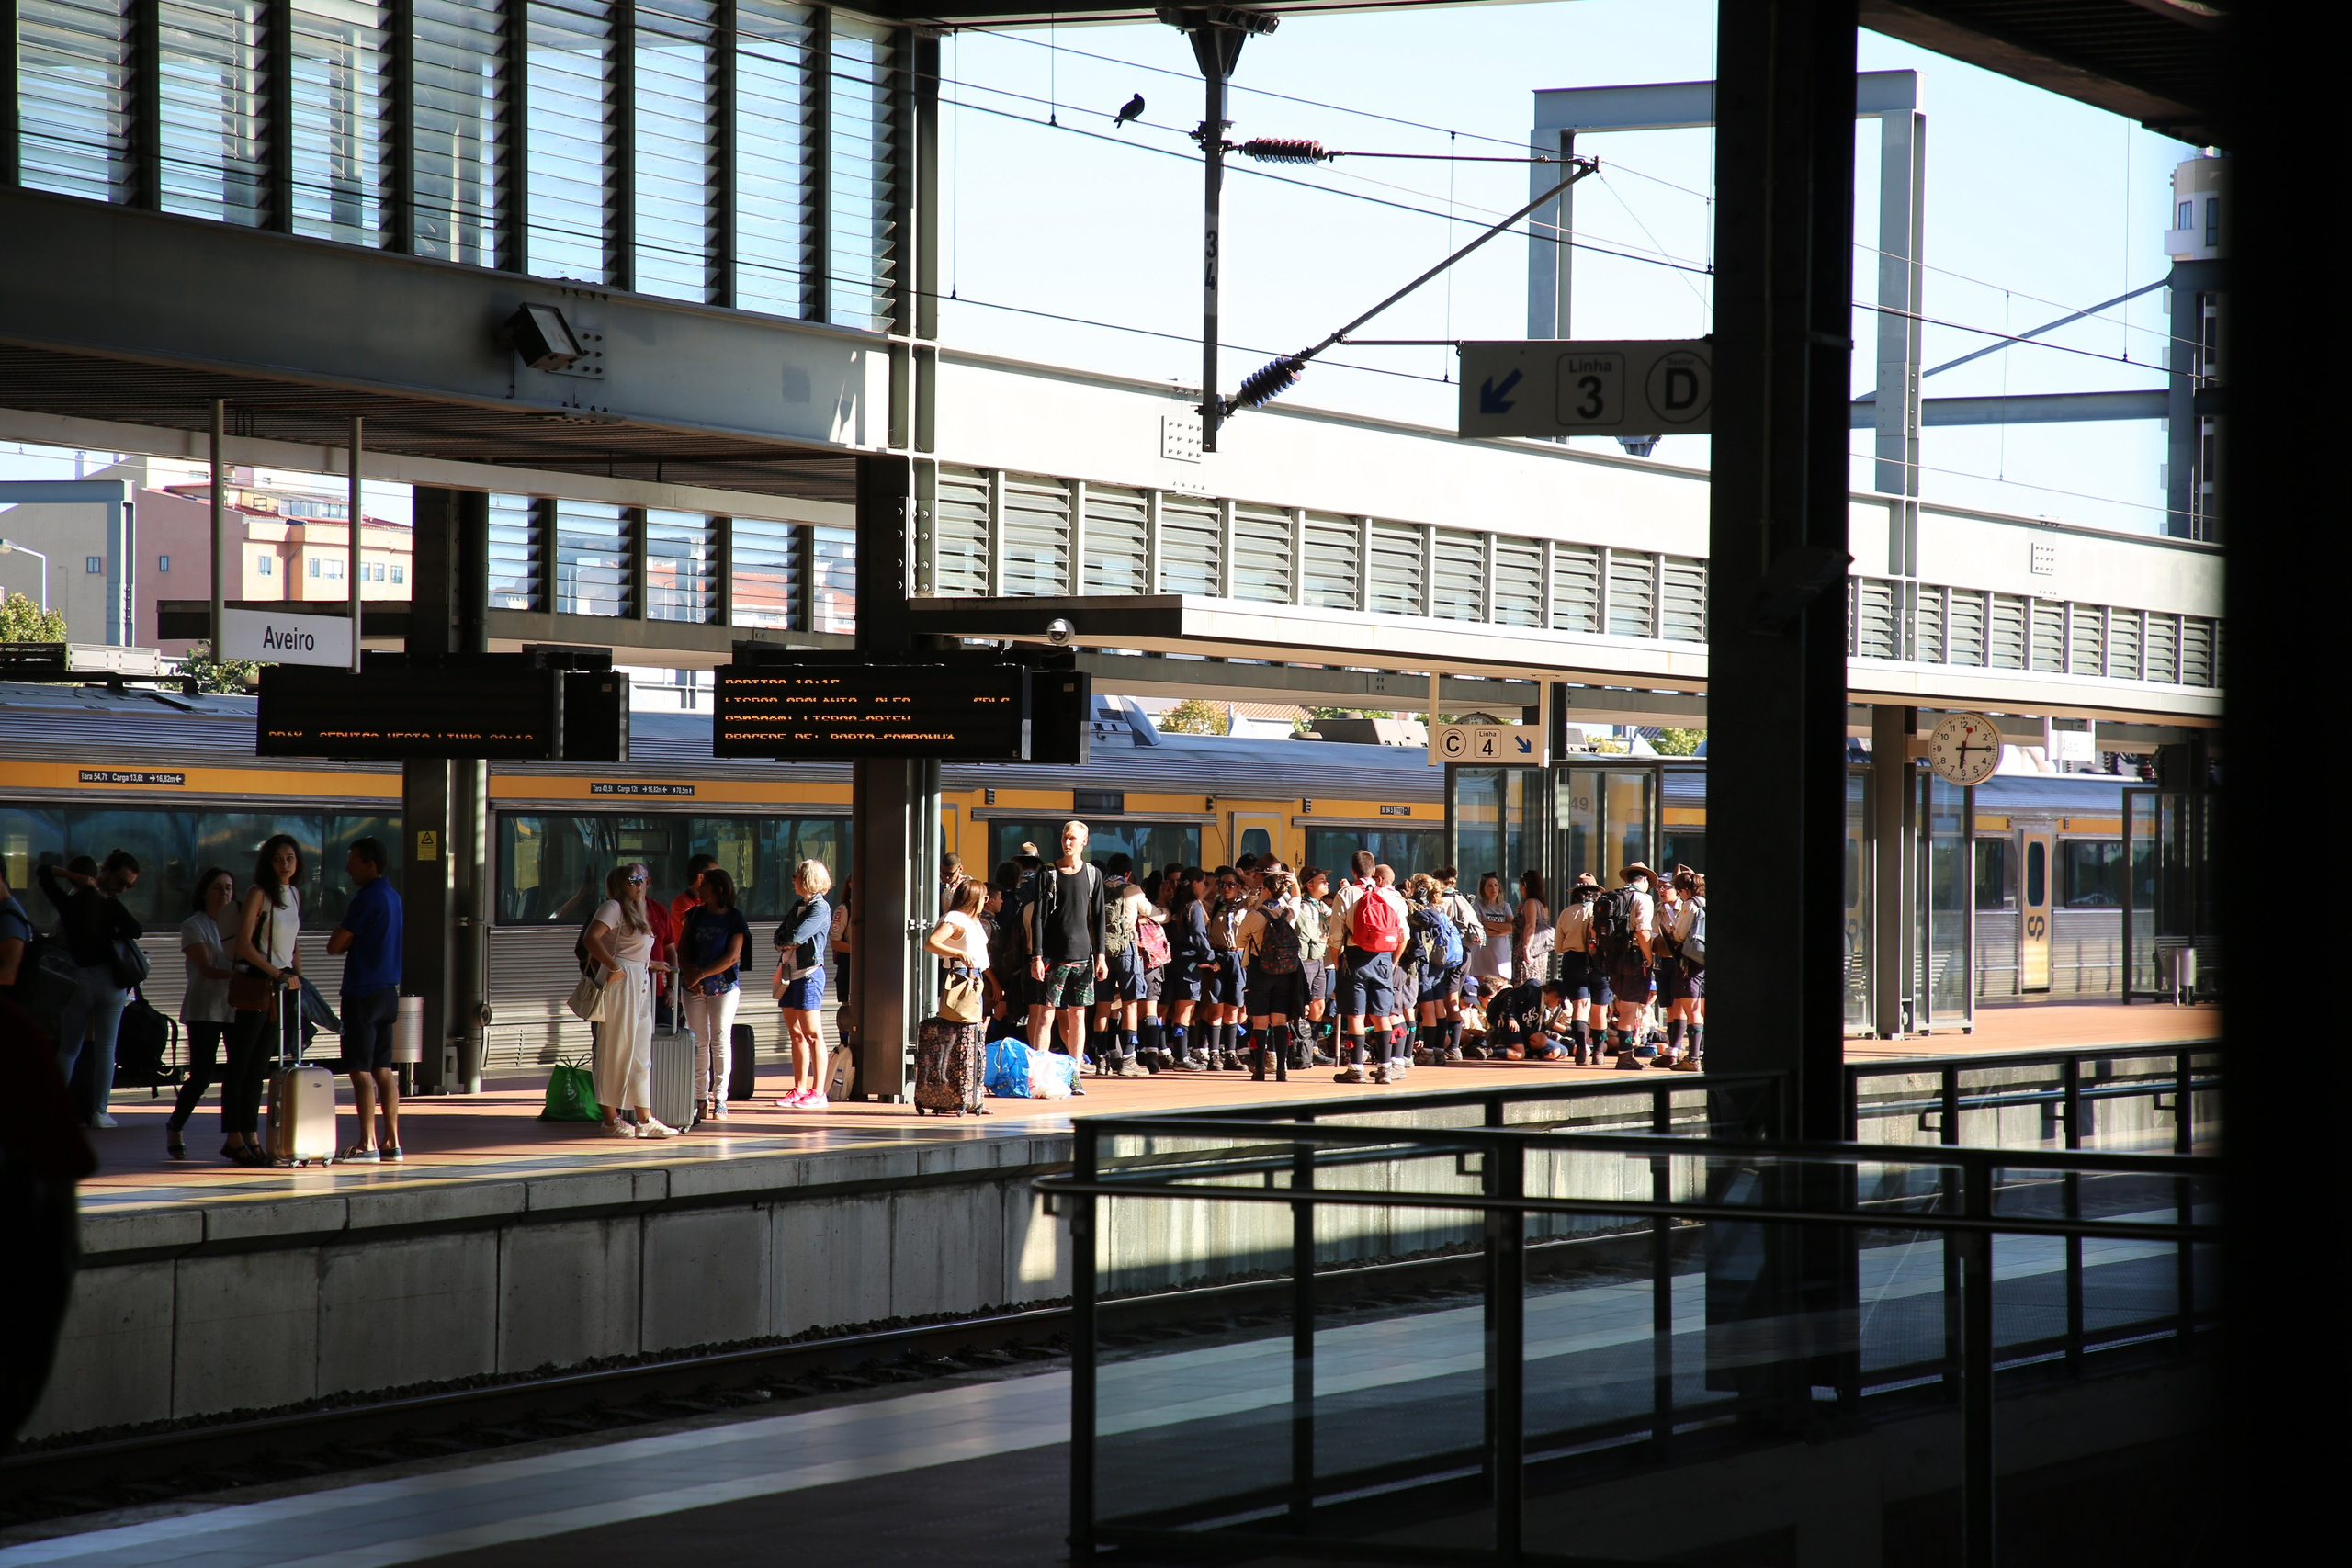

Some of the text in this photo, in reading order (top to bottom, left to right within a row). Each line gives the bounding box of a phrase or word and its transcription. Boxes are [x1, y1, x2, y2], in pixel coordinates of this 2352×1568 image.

[1568, 358, 1612, 373] Linha
[1665, 367, 1699, 410] D
[1577, 375, 1604, 420] 3
[263, 625, 314, 651] Aveiro
[1446, 736, 1460, 752] C
[1482, 739, 1494, 756] 4
[112, 773, 129, 783] Carga
